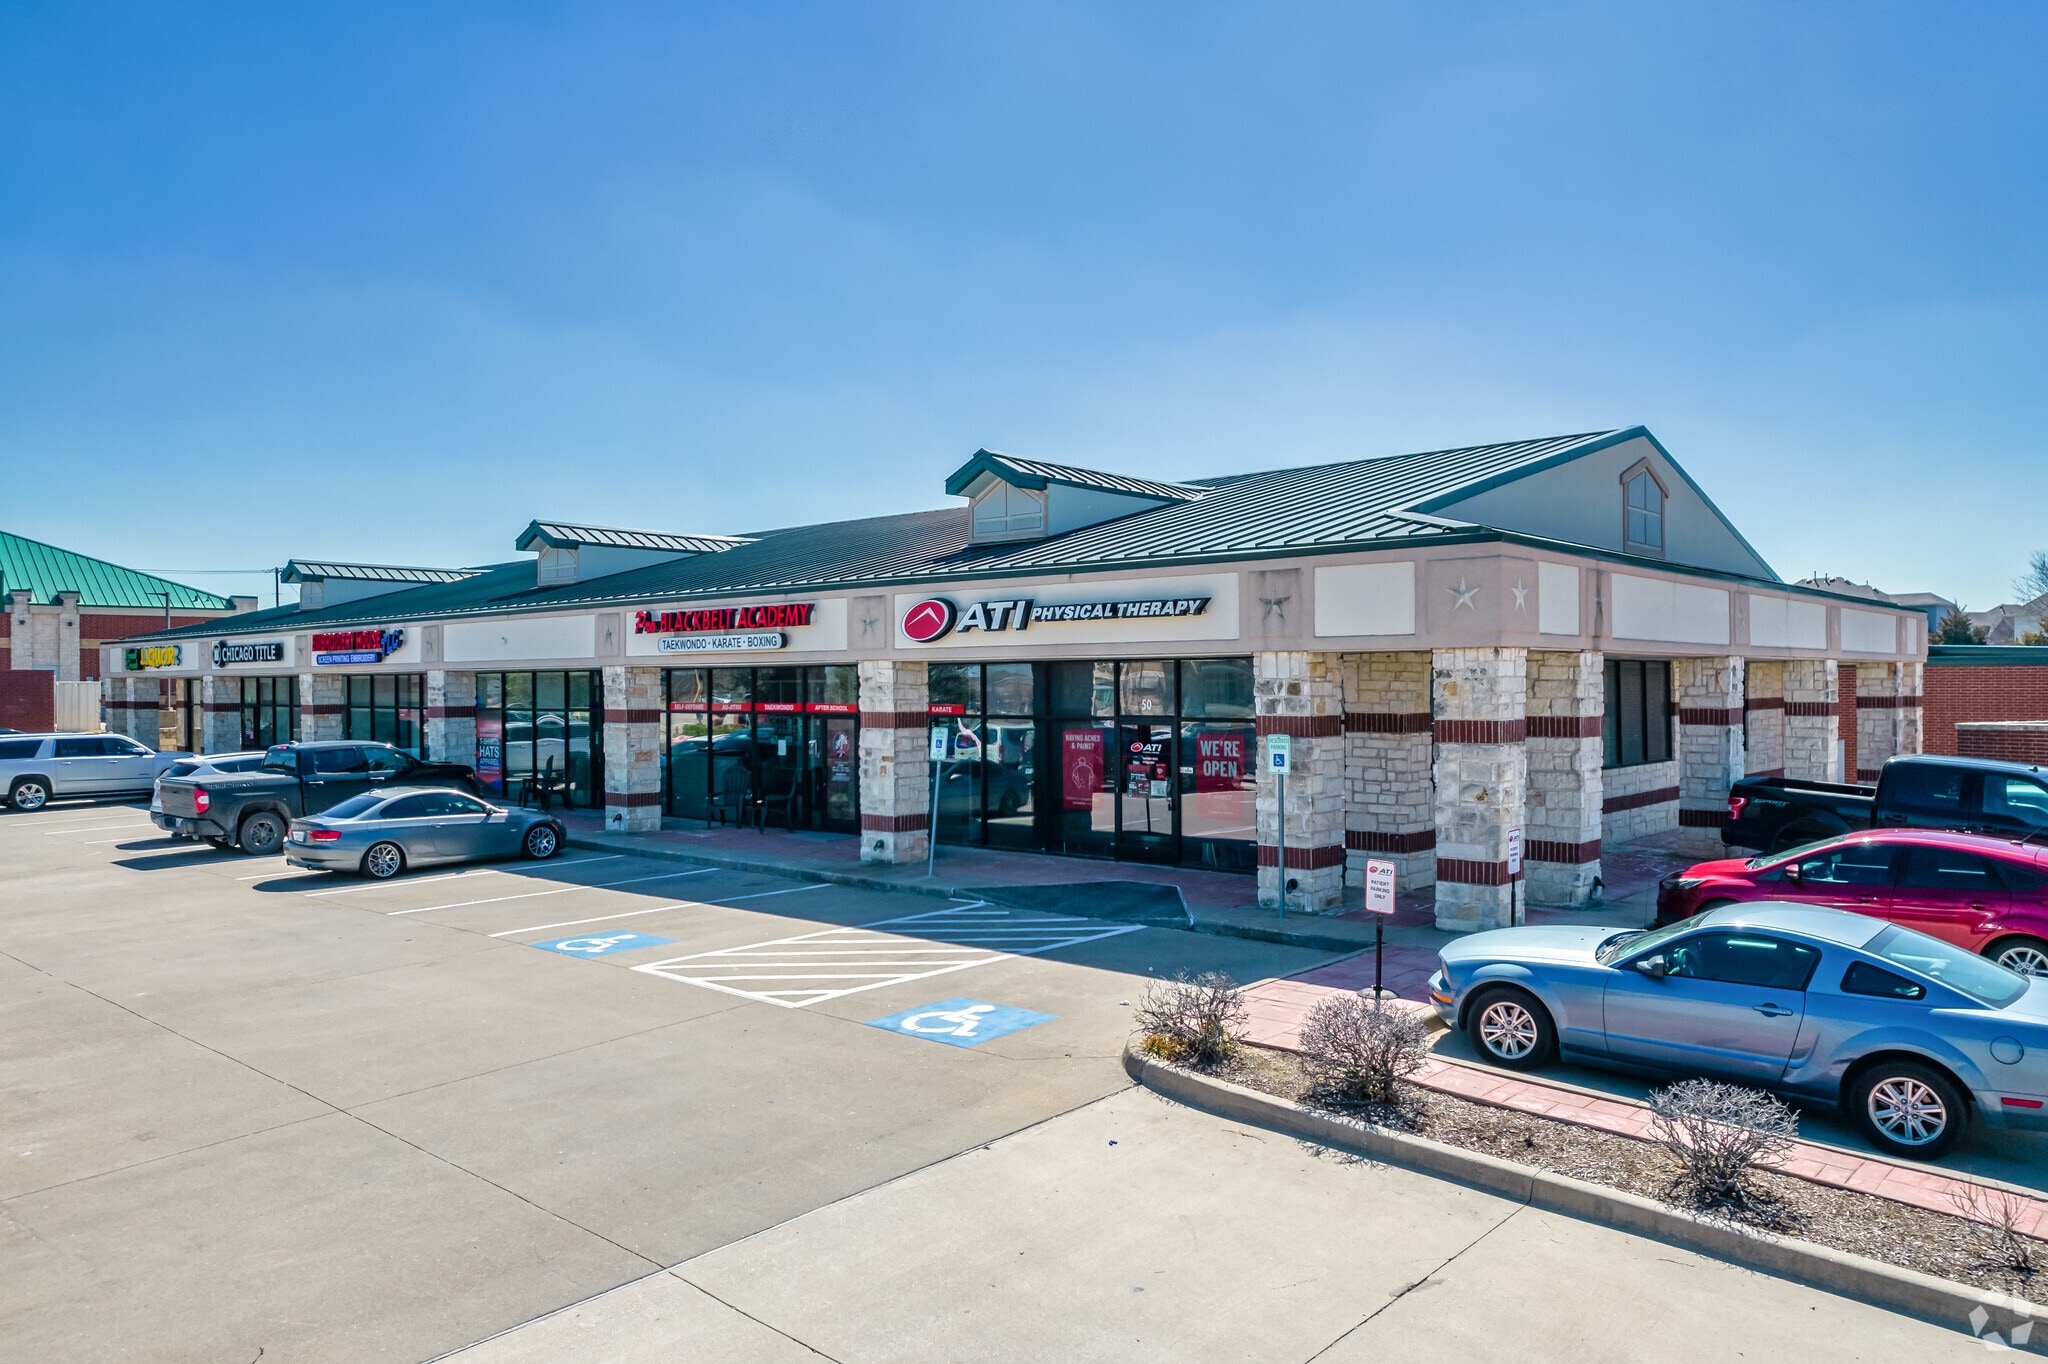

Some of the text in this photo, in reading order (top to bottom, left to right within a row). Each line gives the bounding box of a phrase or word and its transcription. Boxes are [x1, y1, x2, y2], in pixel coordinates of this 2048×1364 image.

[660, 608, 733, 633] BLACKBELT
[737, 603, 809, 629] ACADEMY
[955, 599, 1027, 632] ATI
[1030, 599, 1201, 621] PHYSICAL THERAPY
[356, 630, 382, 649] HOUSE
[381, 629, 399, 657] TLC
[662, 636, 778, 650] TAEKWONDO KARATE BOXING
[140, 645, 176, 667] LIQUOR
[222, 645, 276, 661] CHICAGO TITLE
[1141, 699, 1152, 711] 50
[1065, 734, 1083, 742] HAVING
[480, 745, 500, 758] HATS
[1142, 743, 1162, 752] ATI
[1200, 740, 1240, 757] WE'RE
[1203, 760, 1237, 777] OPEN
[1370, 886, 1390, 894] PARKING
